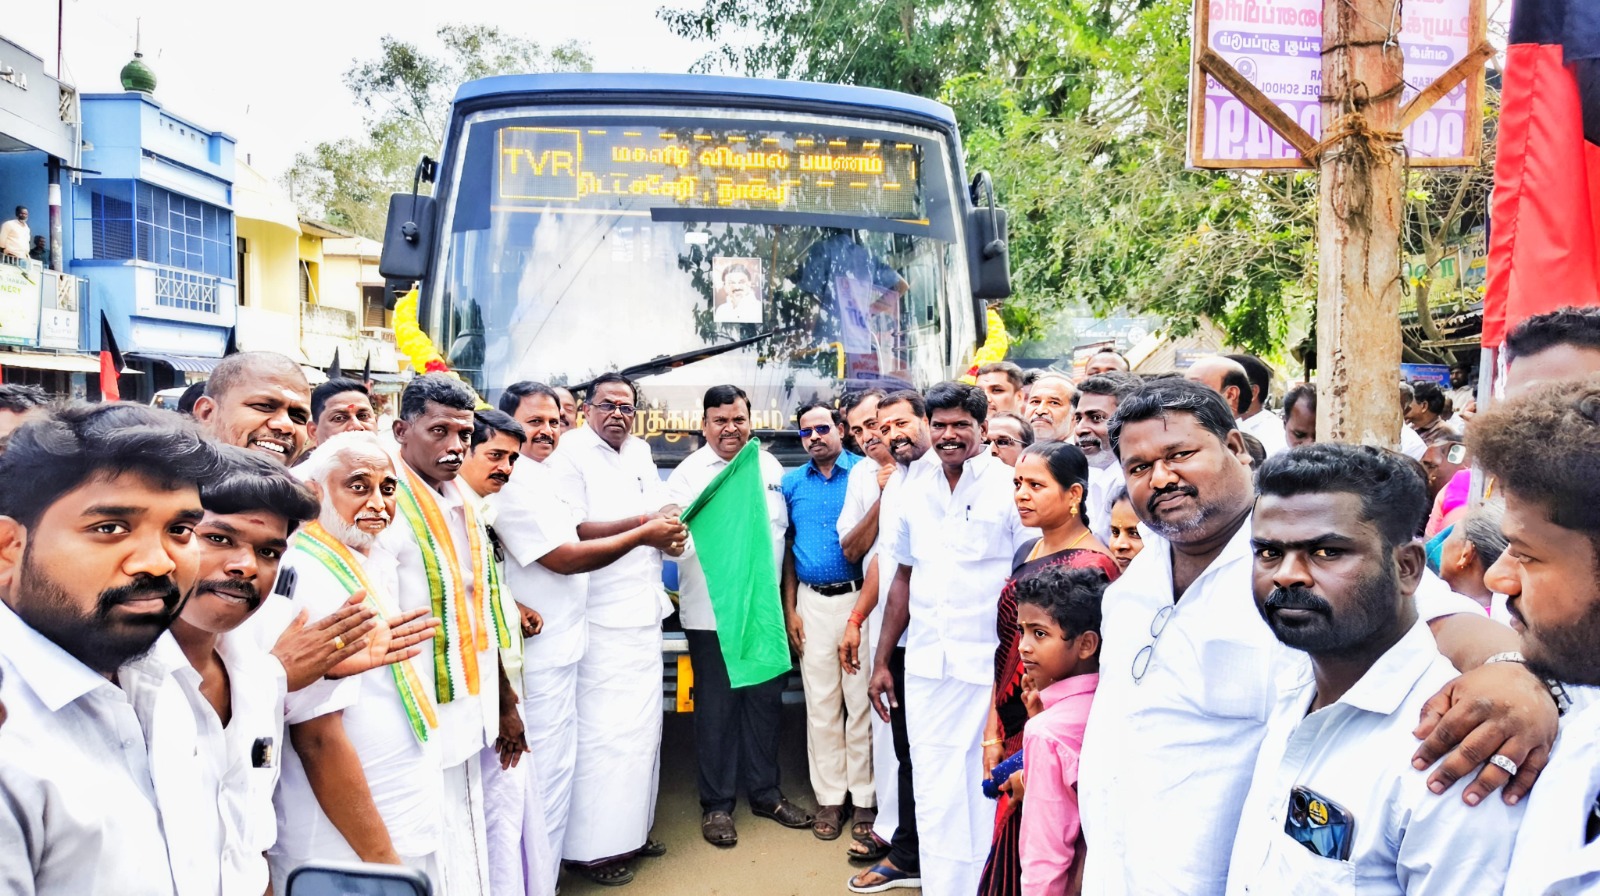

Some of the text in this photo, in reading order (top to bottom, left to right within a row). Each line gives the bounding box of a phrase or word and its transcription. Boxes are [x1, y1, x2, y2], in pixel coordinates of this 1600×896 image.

[503, 148, 576, 177] TVR
[700, 146, 788, 172] விடியல்
[800, 153, 883, 174] பயணம்
